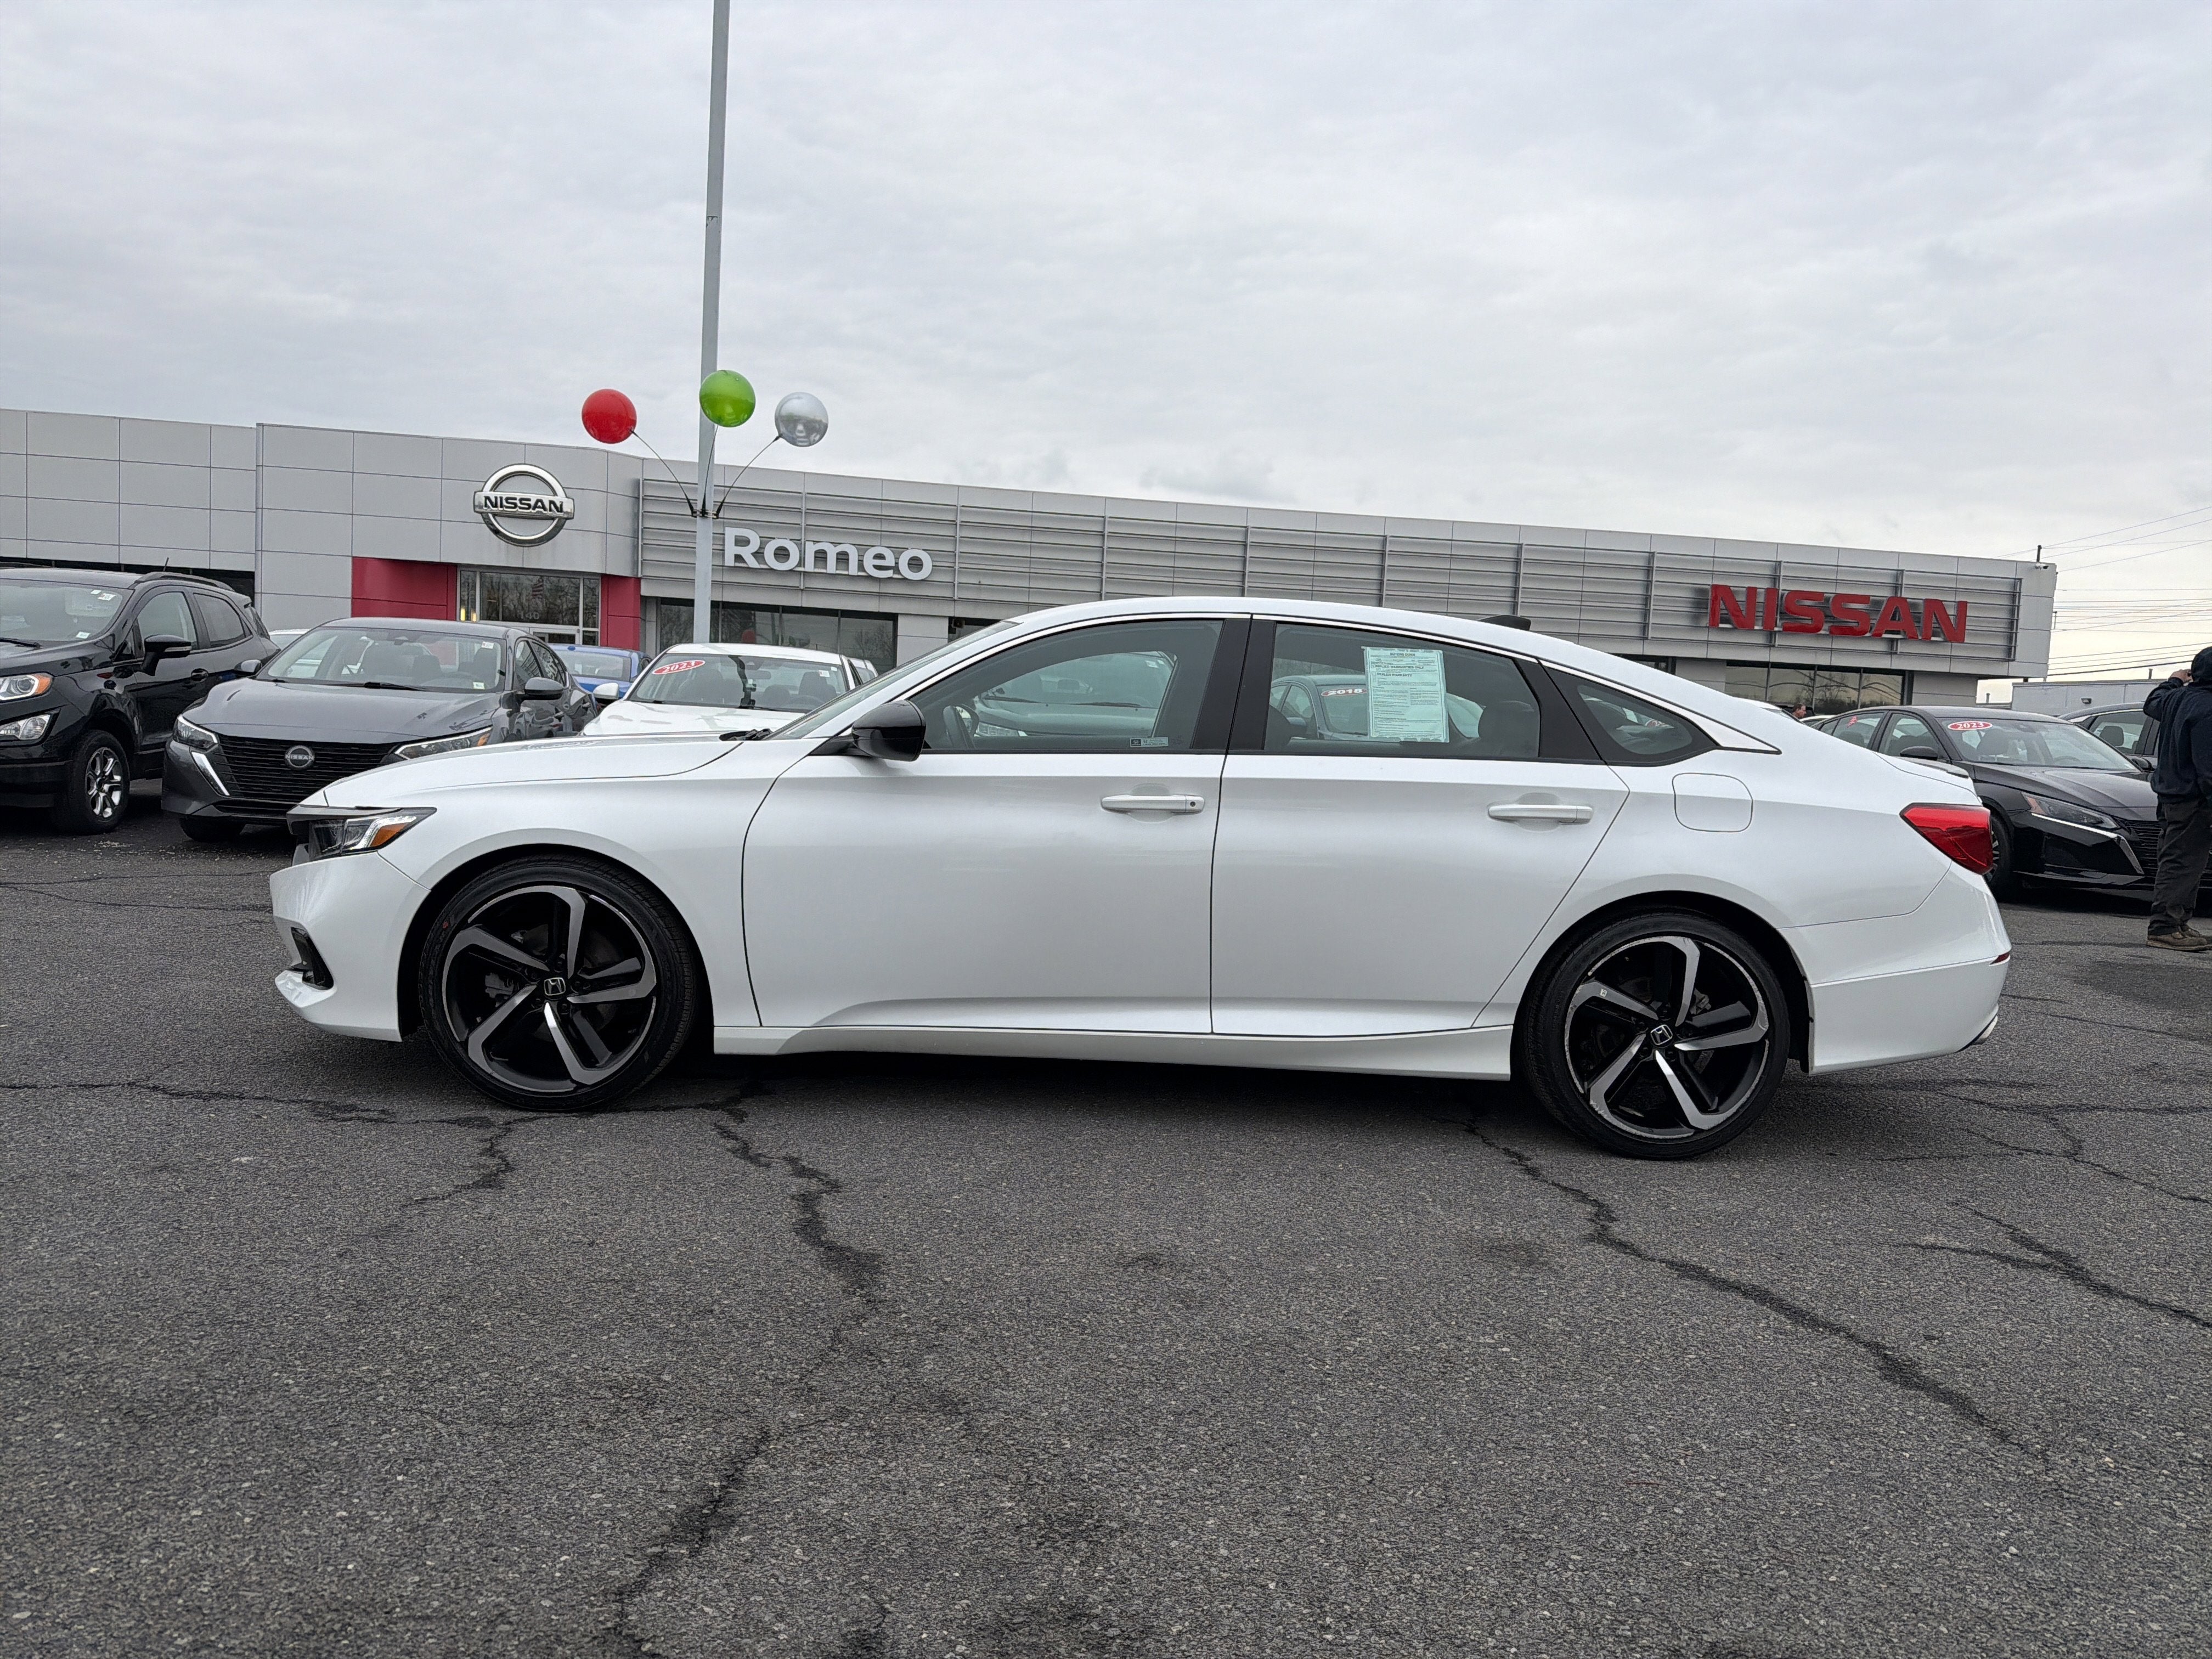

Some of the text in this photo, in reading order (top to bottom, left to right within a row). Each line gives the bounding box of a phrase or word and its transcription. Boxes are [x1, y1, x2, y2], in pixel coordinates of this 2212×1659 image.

[483, 495, 563, 513] NISSAN
[724, 527, 933, 580] Romeo
[1708, 584, 1968, 643] NISSAN
[662, 661, 696, 673] 2023
